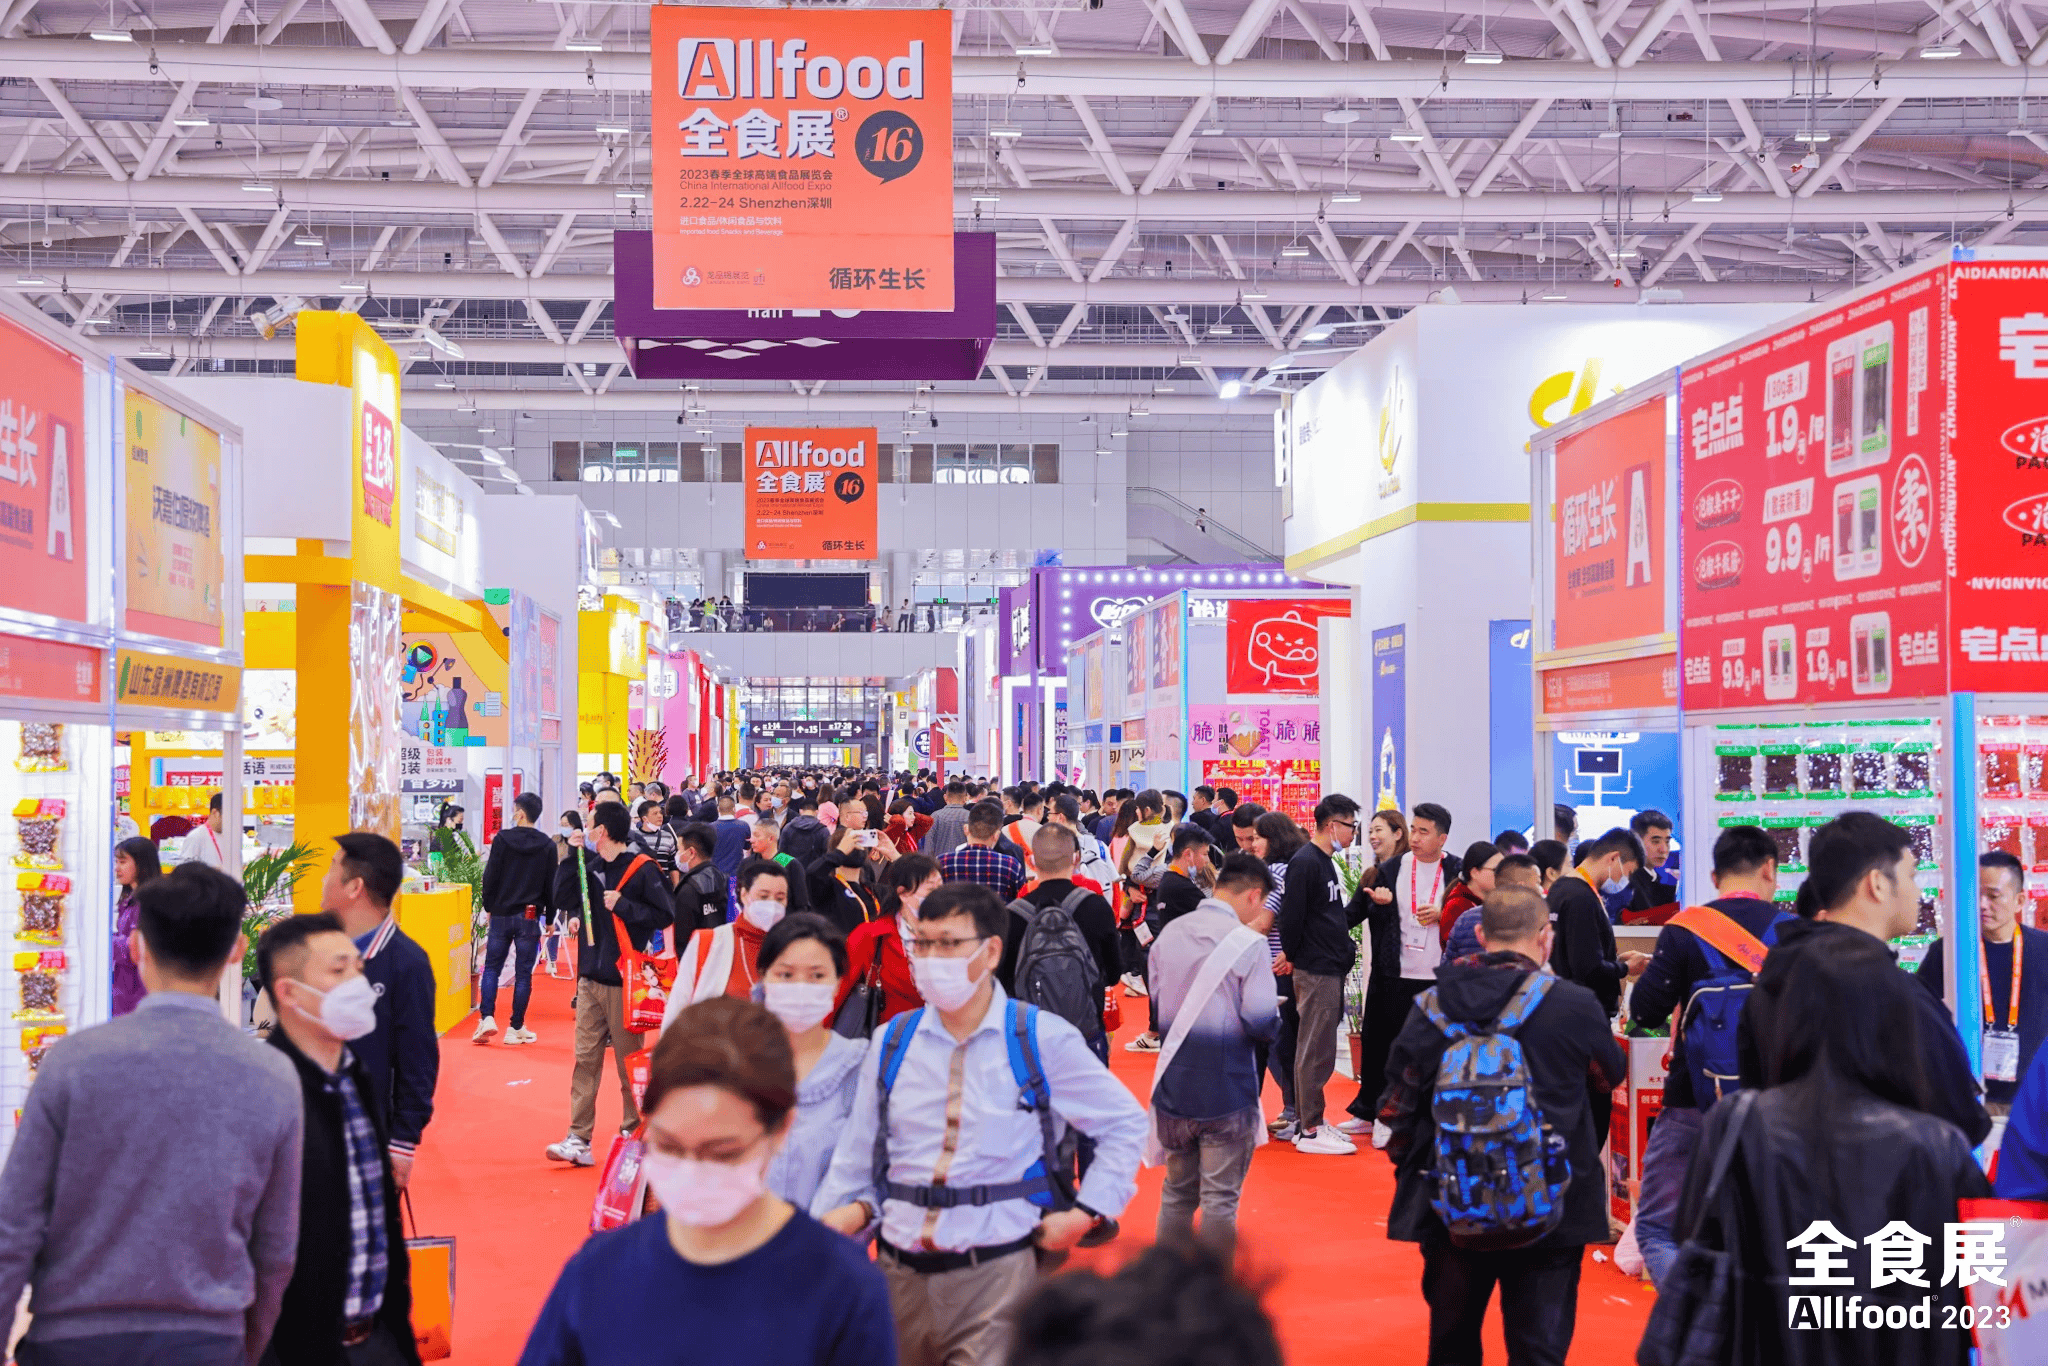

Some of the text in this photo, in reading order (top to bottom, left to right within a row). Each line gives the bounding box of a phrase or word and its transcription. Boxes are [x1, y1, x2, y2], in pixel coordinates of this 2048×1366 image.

[678, 38, 924, 101] Allfood
[870, 127, 913, 163] 16
[680, 169, 833, 181] 2023春季全球高端食品展览会
[680, 181, 832, 192] China International Allfood Expo
[680, 197, 735, 209] 2.22-24
[680, 216, 782, 226] 进口食品/休闲食品与饮料
[829, 267, 926, 291] 循环生长
[1691, 395, 1744, 460] 宅点点
[1766, 405, 1799, 459] 1.9
[756, 440, 865, 468] Allfood
[840, 479, 860, 495] 16
[1563, 479, 1617, 557] 循环生长
[1895, 468, 1927, 554] 素
[822, 540, 865, 551] 循环生长
[1766, 522, 1803, 575] 9.9
[1899, 630, 1940, 666] 宅点点
[1960, 626, 2048, 662] 宅点
[1722, 658, 1745, 689] 9.9
[1807, 649, 1829, 682] 1.9
